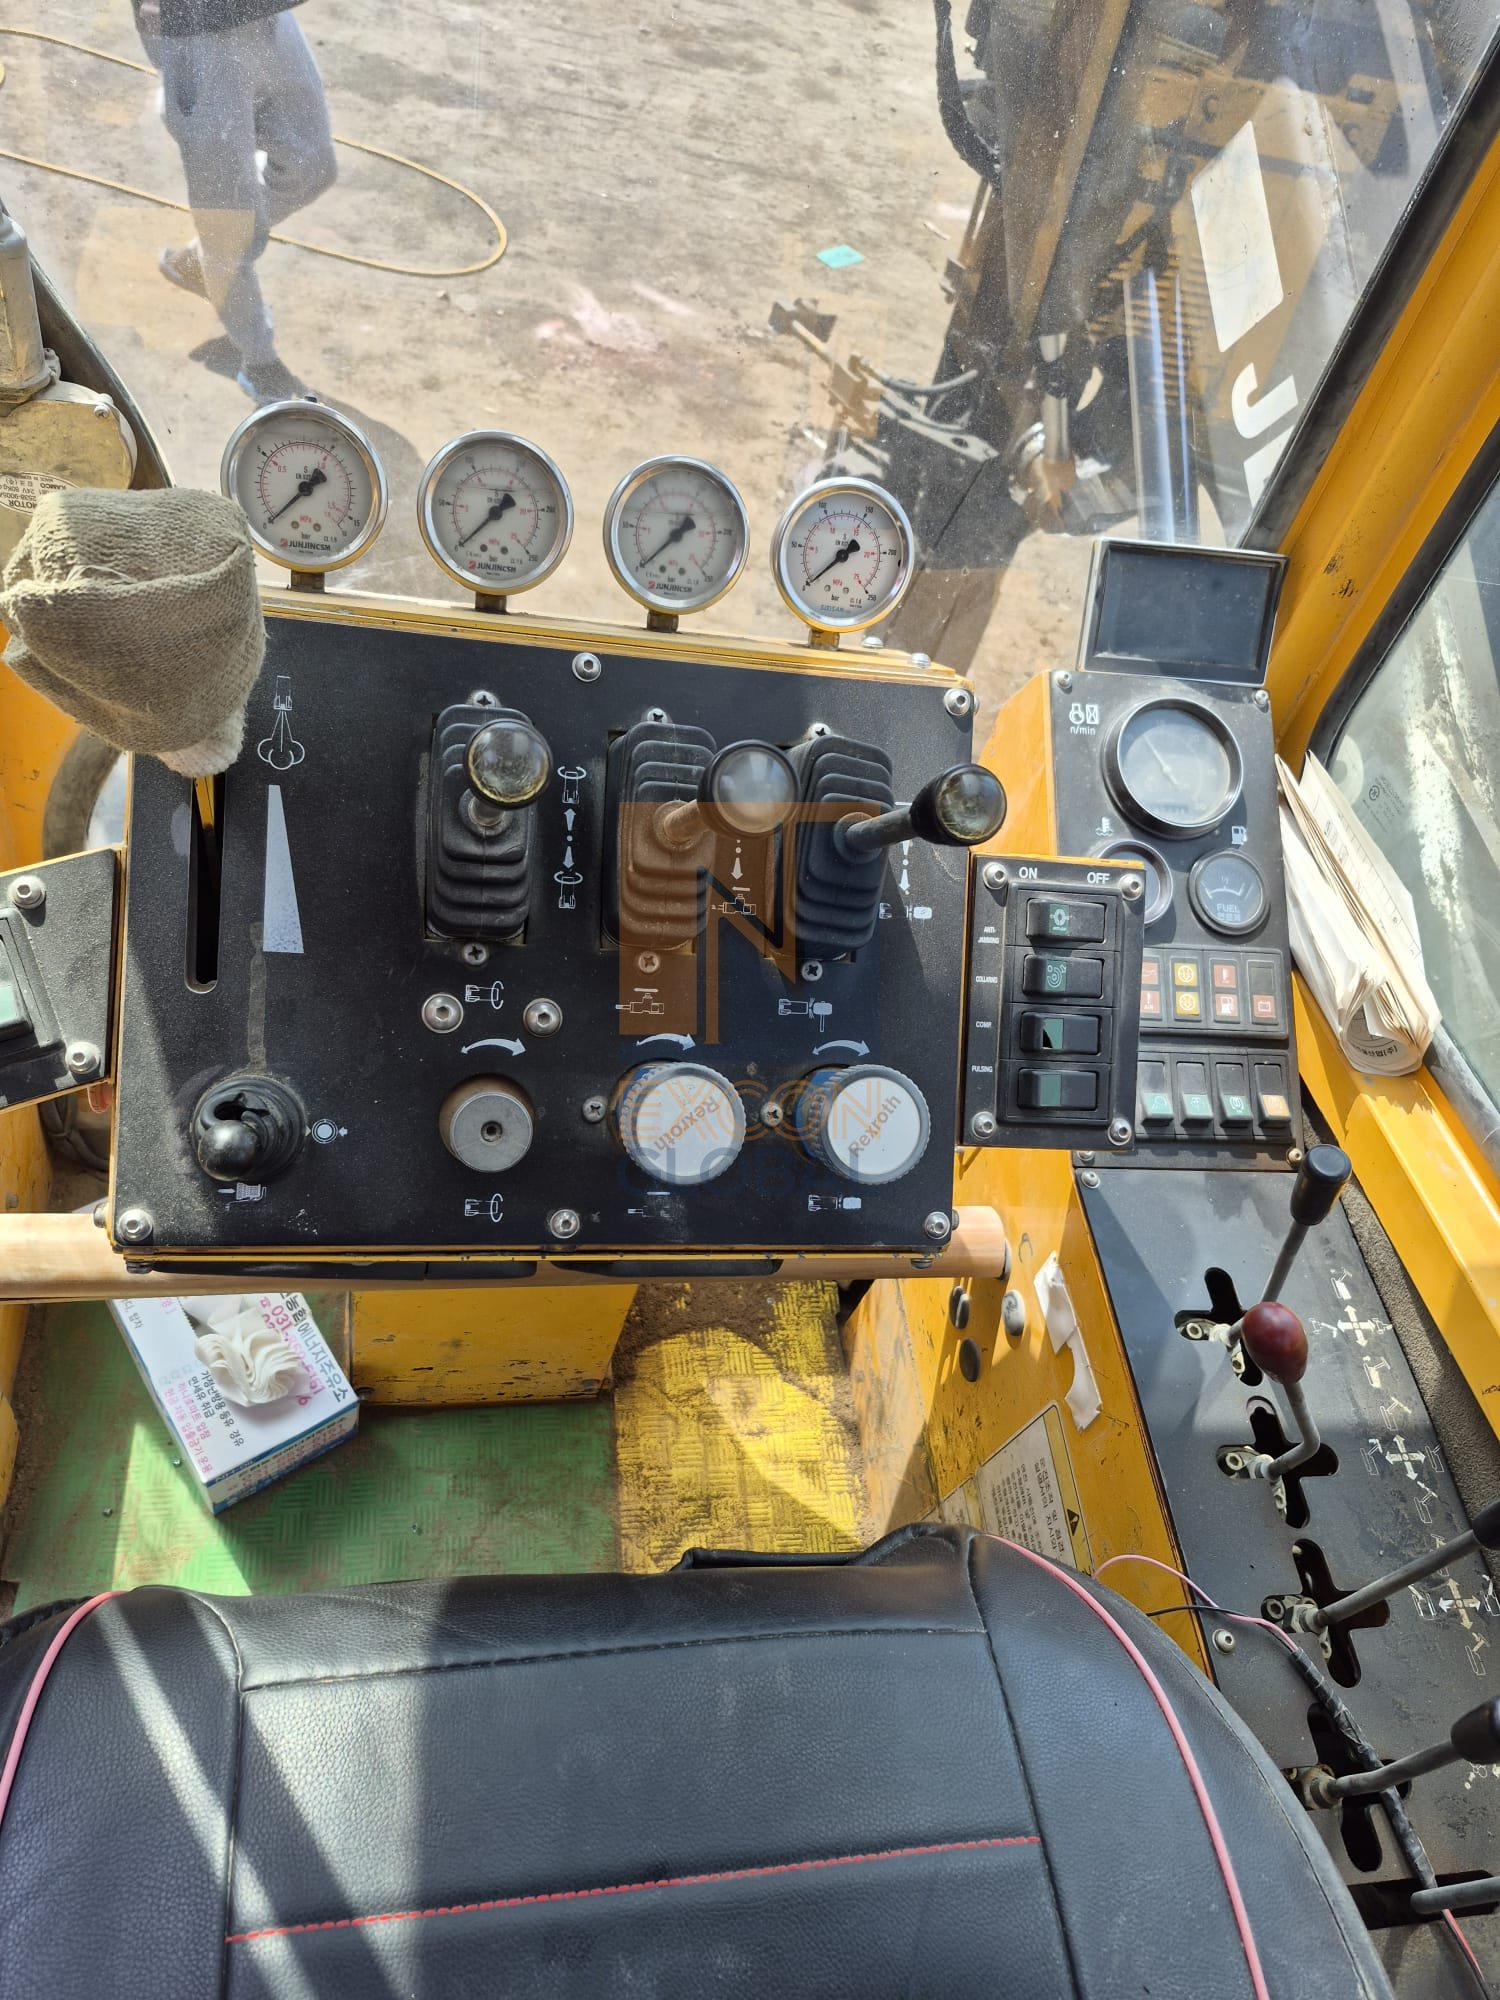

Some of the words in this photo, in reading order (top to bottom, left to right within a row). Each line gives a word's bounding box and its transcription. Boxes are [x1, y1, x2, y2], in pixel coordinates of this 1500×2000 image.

[353, 519, 360, 527] 15
[301, 531, 311, 539] bar
[288, 539, 331, 551] JUNJINCSM
[477, 562, 516, 573] JUNJINCSM
[831, 593, 840, 601] bar
[1069, 725, 1096, 736] n/min
[1018, 866, 1038, 879] ON
[1086, 872, 1111, 885] OFF
[1216, 903, 1239, 913] FUEL
[971, 1065, 993, 1073] PULSING
[654, 1096, 718, 1151] Rexroth
[847, 1095, 901, 1159] Rexroth
[201, 1401, 215, 1418] 취급
